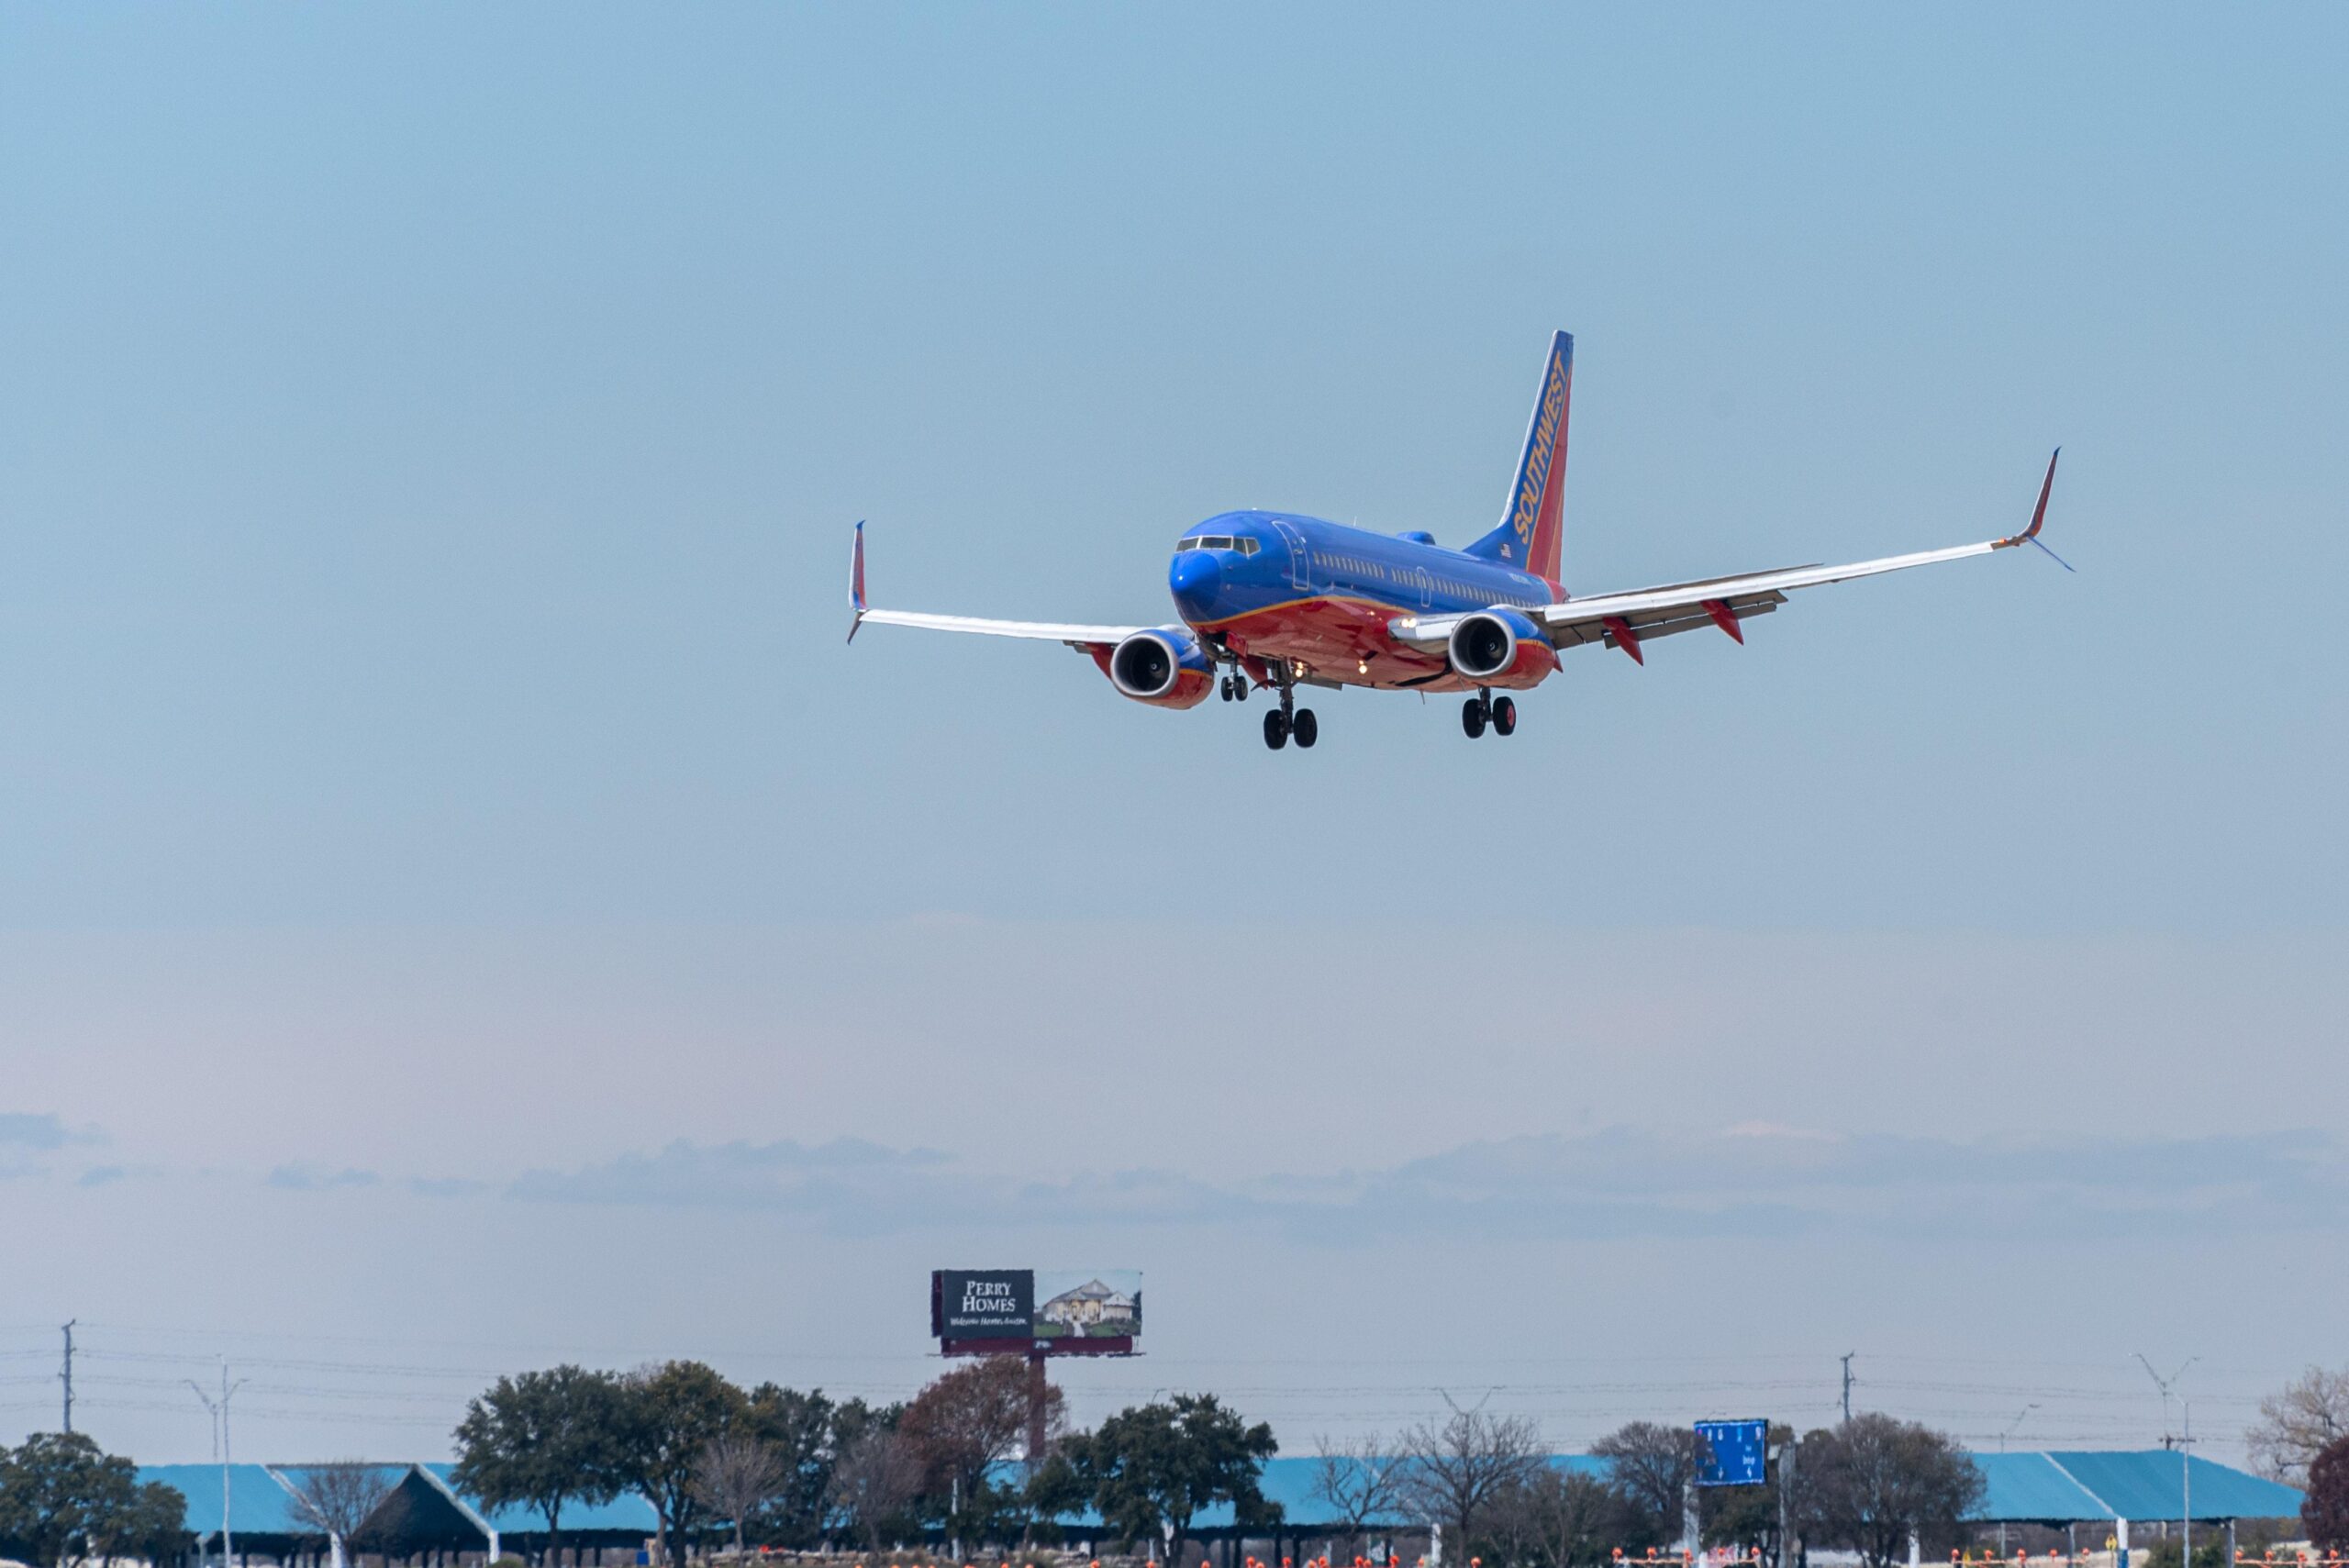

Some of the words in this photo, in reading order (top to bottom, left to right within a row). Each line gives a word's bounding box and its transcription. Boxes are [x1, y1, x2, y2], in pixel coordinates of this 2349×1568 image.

[1515, 351, 1566, 544] SOUTHWEST
[966, 1280, 1011, 1296] PERRY
[963, 1296, 1016, 1312] HOMES
